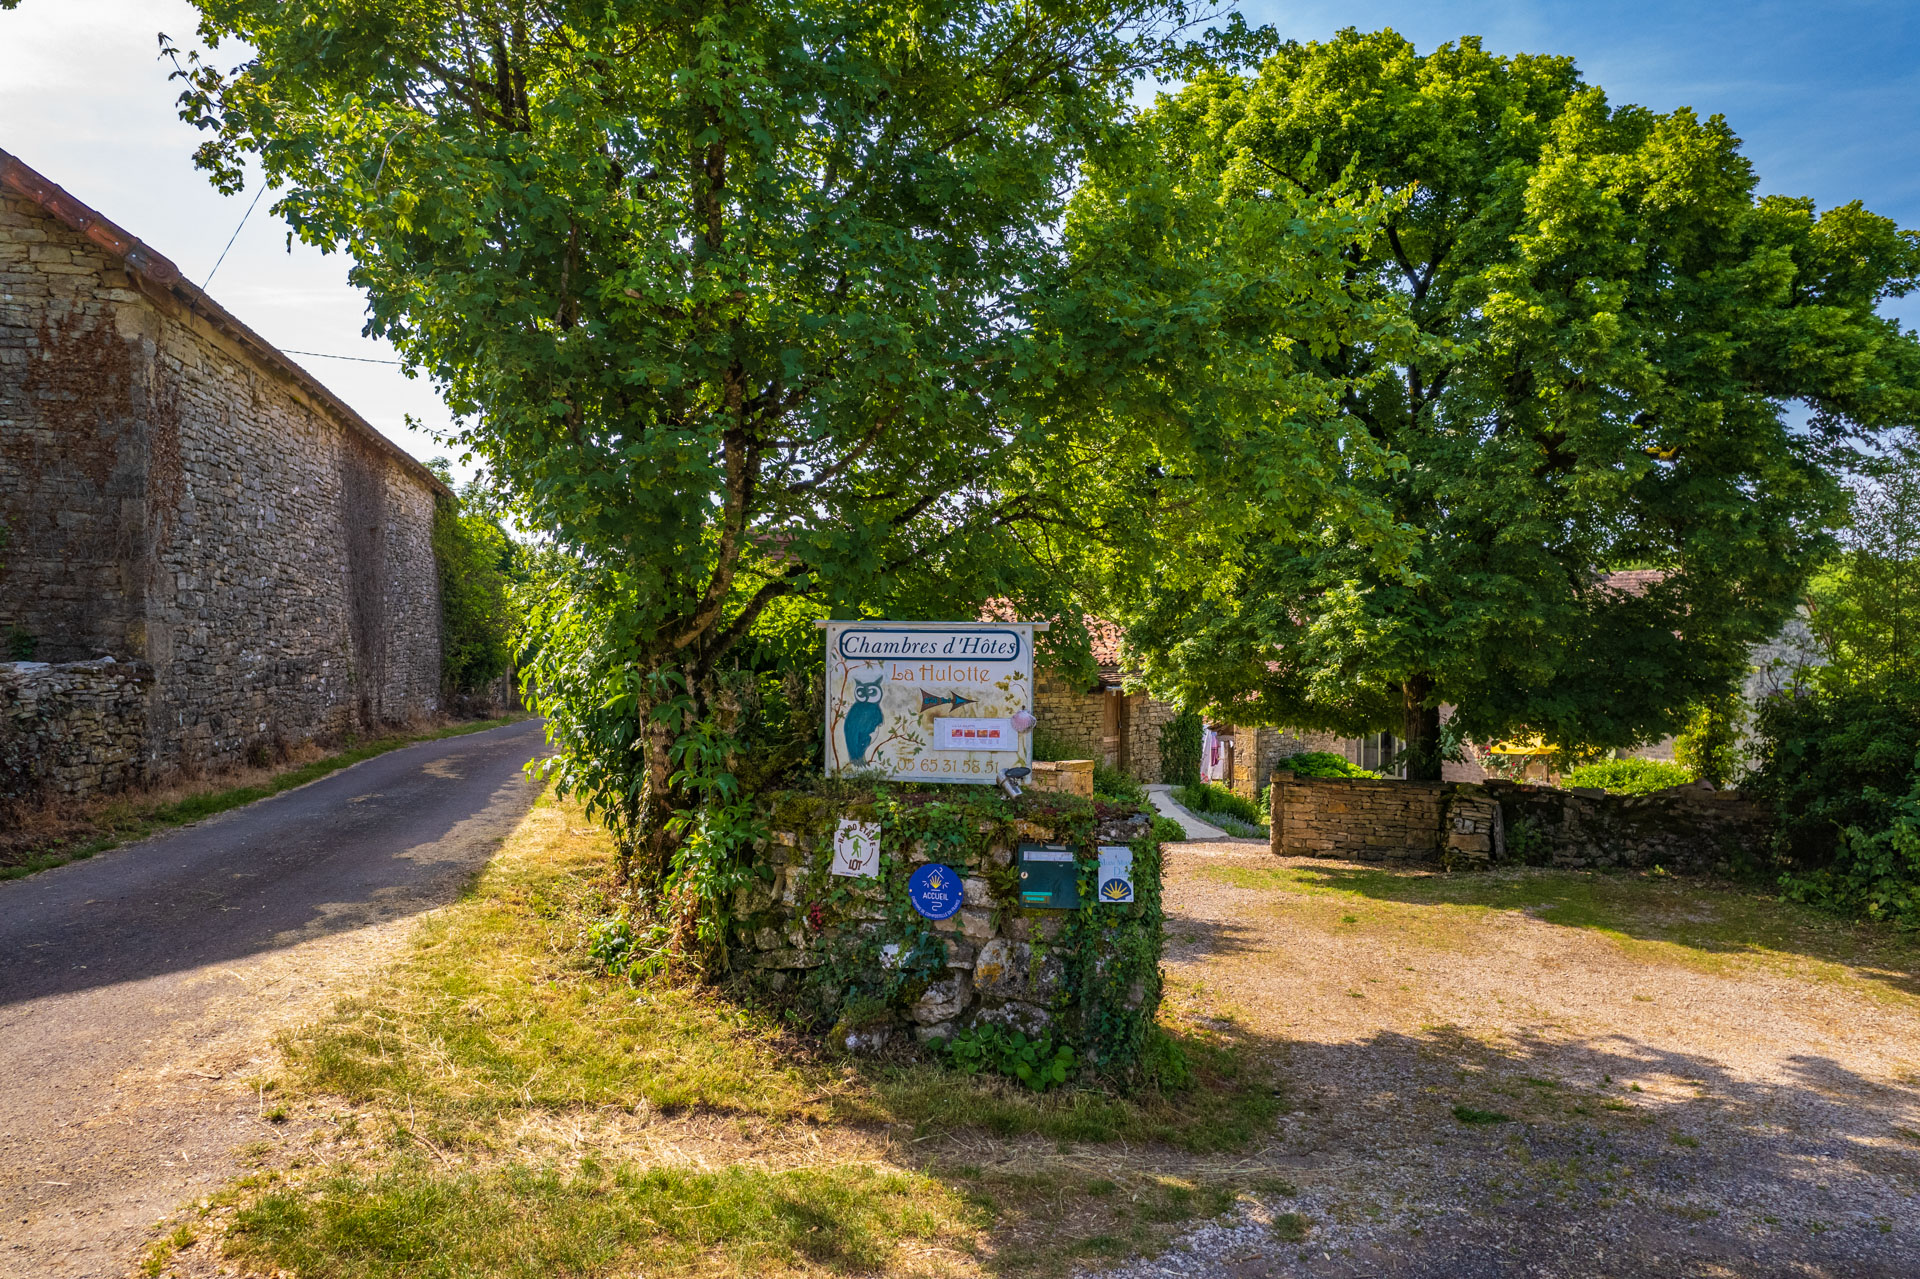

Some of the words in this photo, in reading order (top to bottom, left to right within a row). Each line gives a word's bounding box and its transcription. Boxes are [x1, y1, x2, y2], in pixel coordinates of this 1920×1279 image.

[844, 636, 938, 654] Chambres
[943, 636, 1016, 654] d'Hôtes
[891, 663, 914, 681] La
[919, 663, 991, 684] Hulotte
[848, 859, 863, 871] LOT
[922, 892, 949, 901] ACCUEIL
